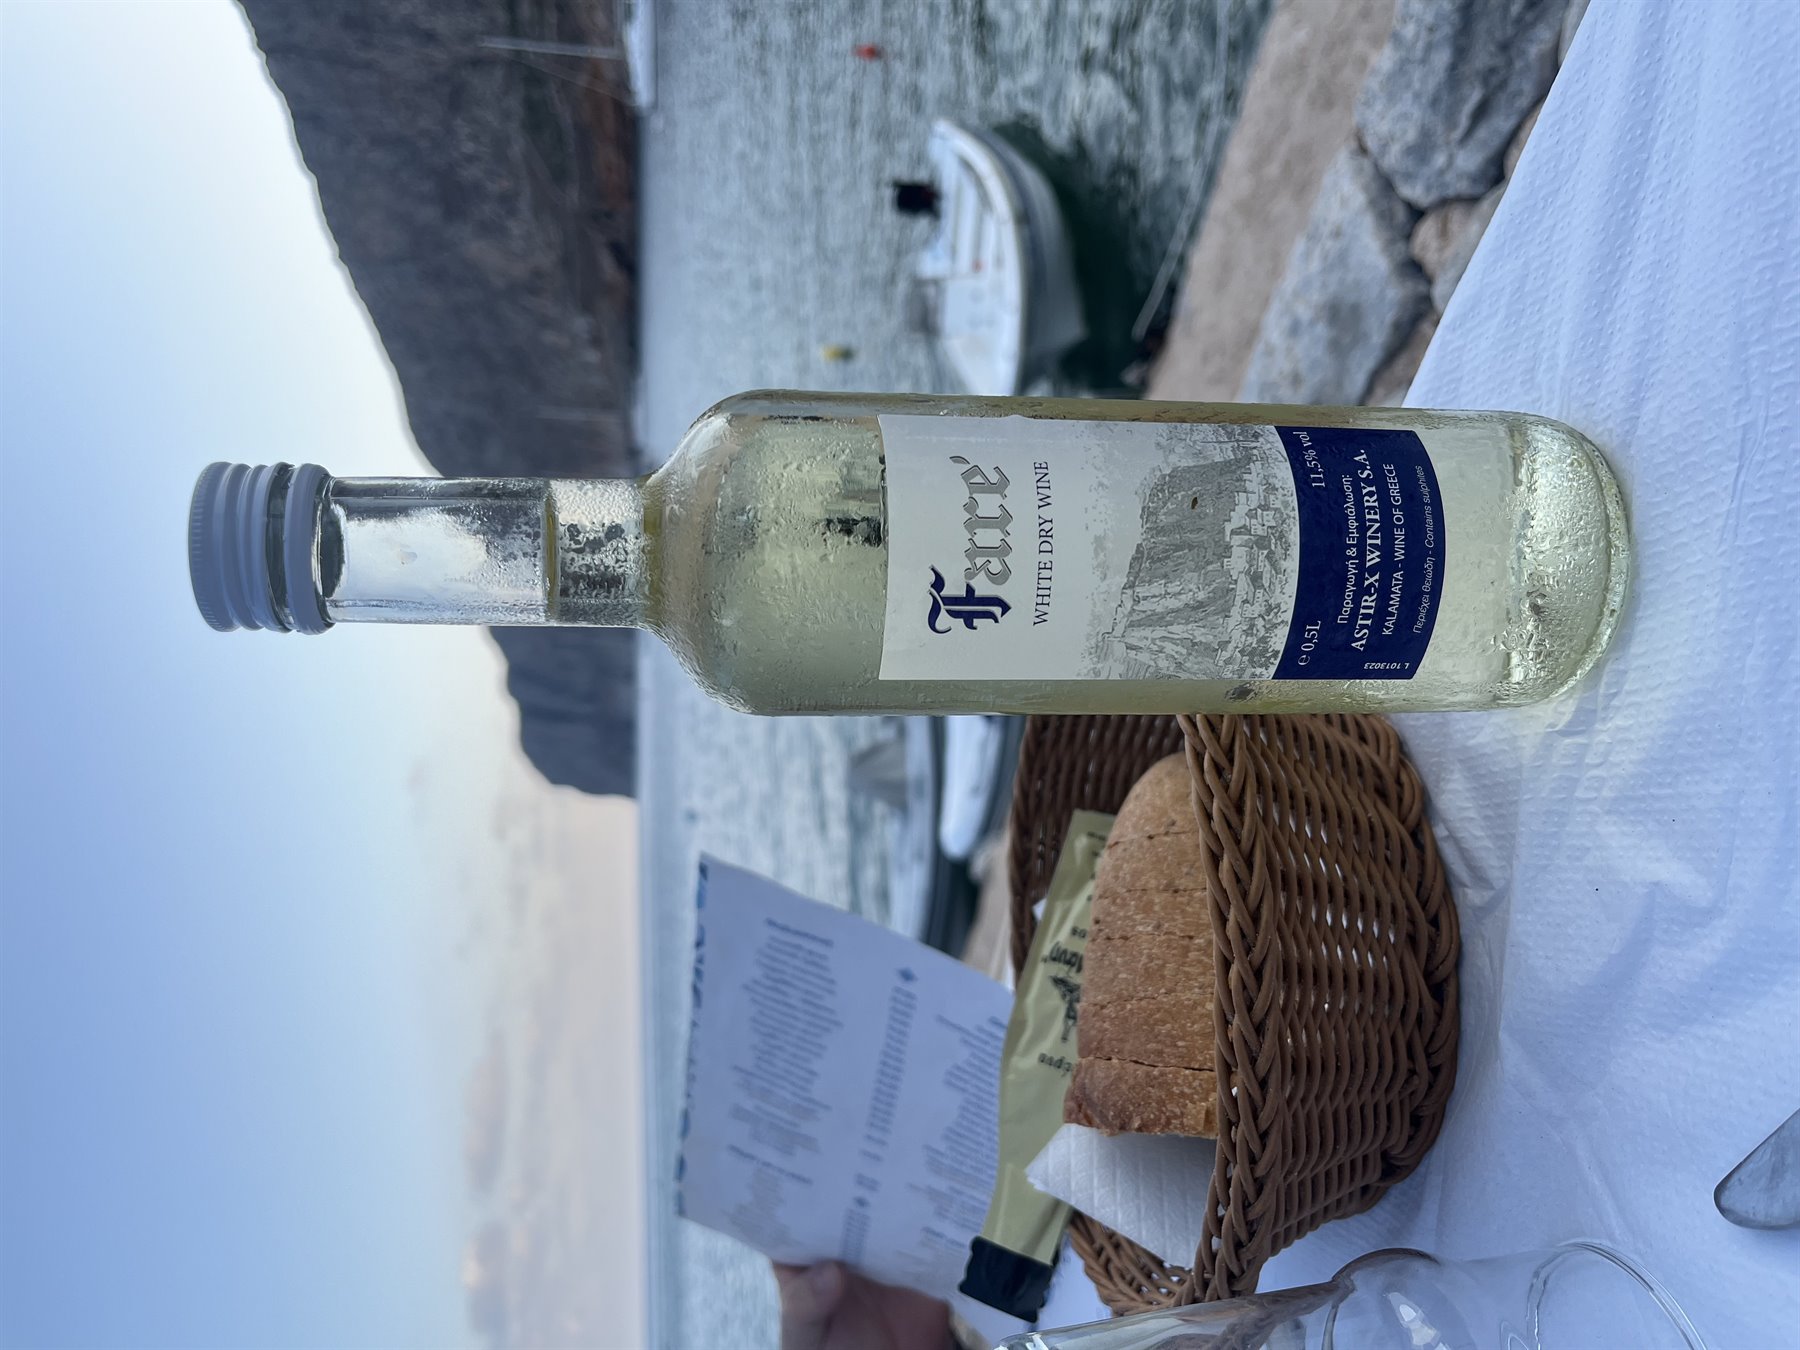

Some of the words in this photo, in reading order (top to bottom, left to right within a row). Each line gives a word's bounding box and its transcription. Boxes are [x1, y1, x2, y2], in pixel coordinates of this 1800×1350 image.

[1293, 431, 1311, 448] vol
[1306, 449, 1326, 487] 11,5%
[1354, 450, 1373, 479] S.A.
[1034, 462, 1052, 509] WINE
[1383, 463, 1402, 510] GREECE
[1415, 466, 1431, 503] sulphites
[1341, 475, 1361, 544] Εμφιάλωση:
[1361, 484, 1381, 568] WINERY
[1395, 511, 1404, 525] OF
[1425, 506, 1434, 548] Contains
[1038, 516, 1053, 555] DRY
[1346, 547, 1357, 556] &
[1394, 527, 1405, 561] WINE
[1033, 561, 1052, 626] WHITE
[1338, 561, 1359, 623] Παραγωγή
[1421, 557, 1435, 592] θειώδη
[1351, 572, 1380, 651] ASTIR-X
[1383, 570, 1404, 635] KALAMATA
[1413, 594, 1430, 633] Περιέχει
[1301, 621, 1321, 651] 0,5L
